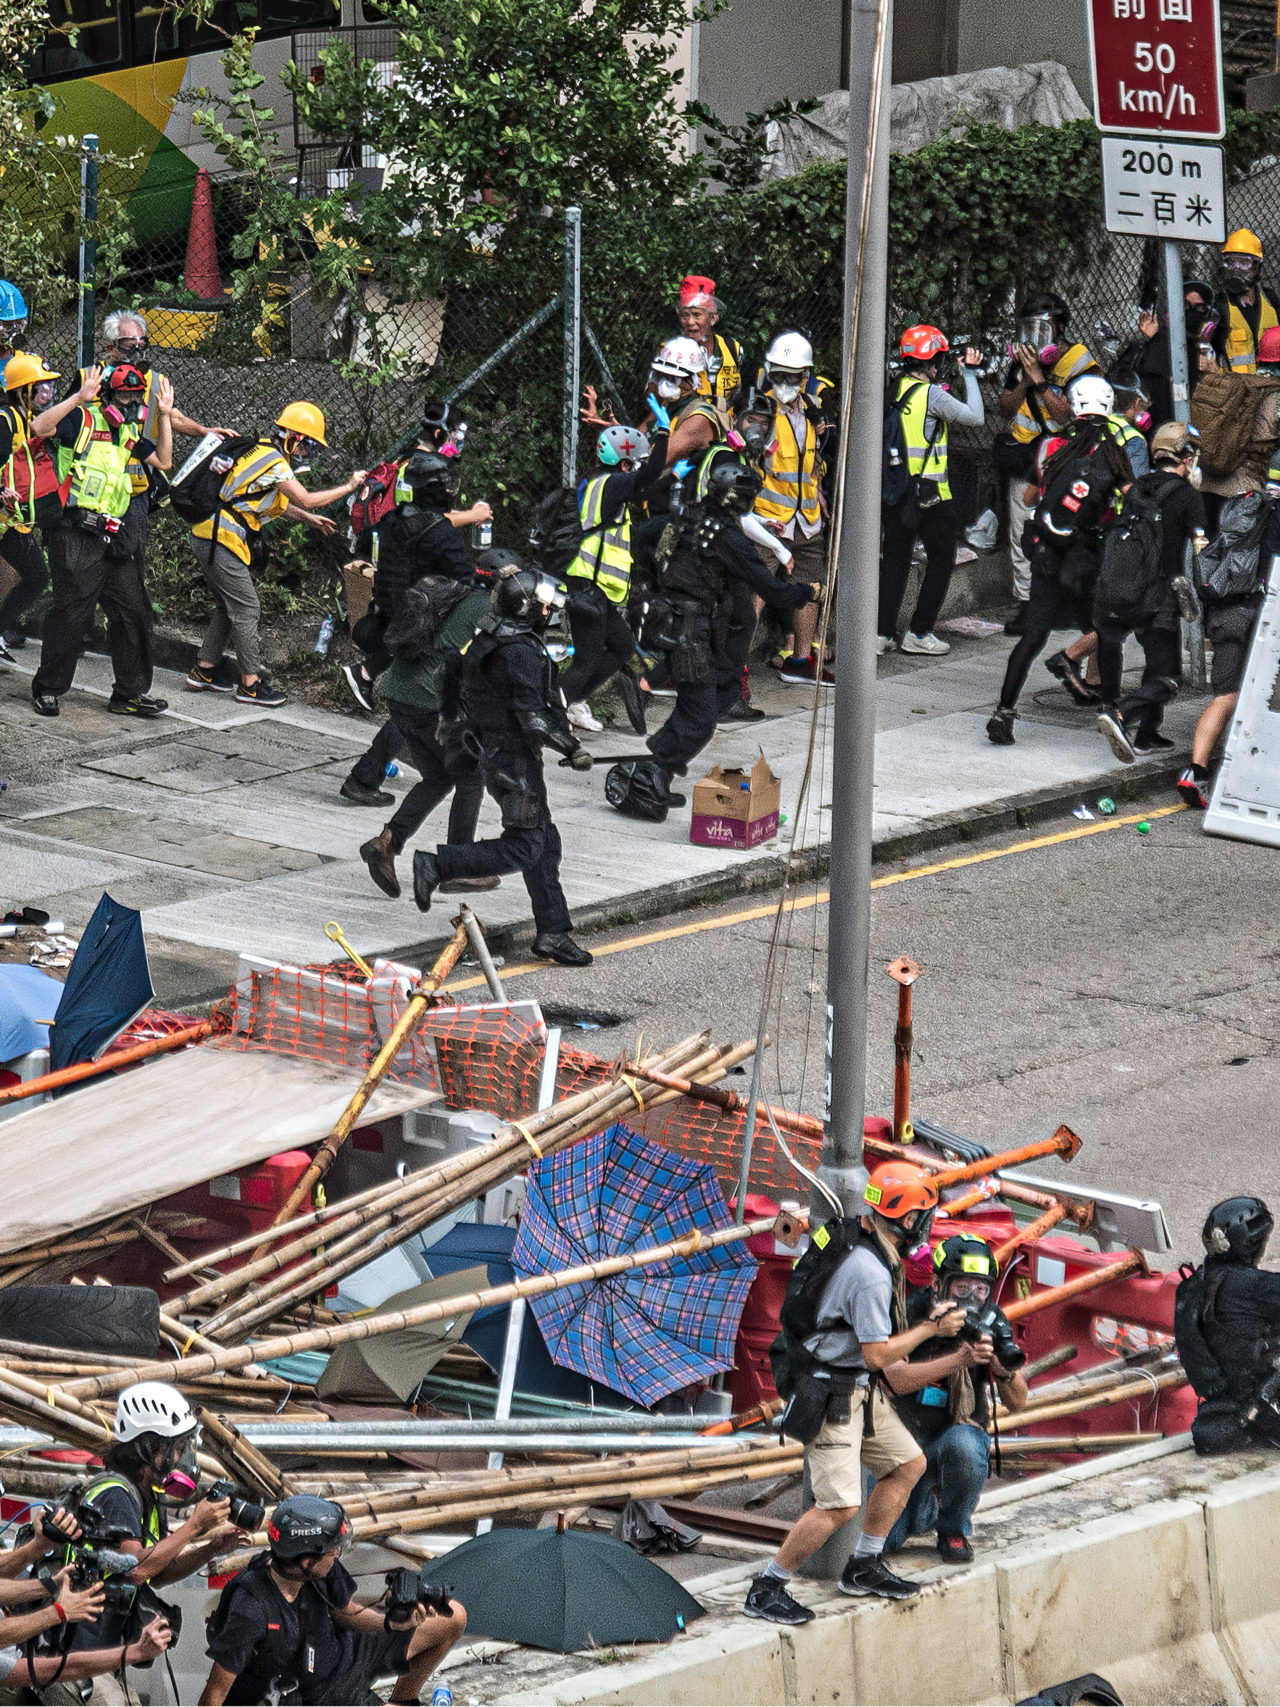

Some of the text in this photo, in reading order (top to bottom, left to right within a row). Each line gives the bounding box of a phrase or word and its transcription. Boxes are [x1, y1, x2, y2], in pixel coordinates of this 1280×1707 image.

[1134, 42, 1176, 74] 50
[1119, 81, 1196, 120] km/h
[1122, 150, 1202, 179] 200 m
[1117, 191, 1213, 226] 二百米
[706, 820, 734, 839] vita
[291, 1527, 323, 1537] PRESS
